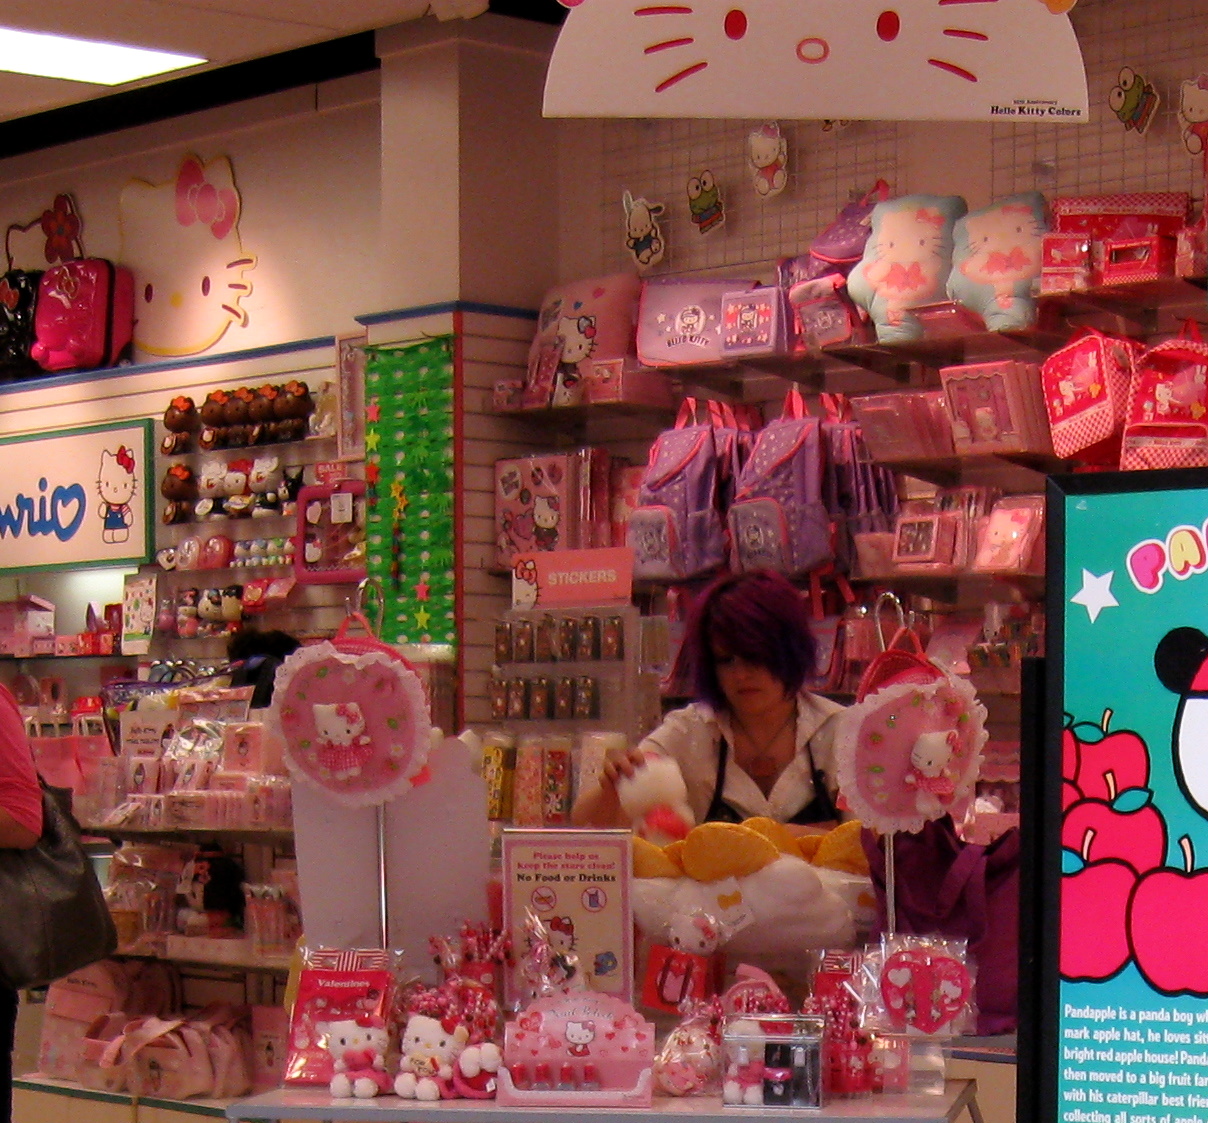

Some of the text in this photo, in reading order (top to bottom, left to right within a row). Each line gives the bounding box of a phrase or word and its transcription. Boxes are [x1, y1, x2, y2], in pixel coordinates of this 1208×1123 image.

[990, 106, 1082, 117] Hello Kitty Colors
[548, 569, 617, 585] STICKERS
[533, 851, 561, 860] Please
[565, 852, 585, 860] help
[517, 873, 532, 882] No
[535, 873, 560, 882] Food
[579, 873, 616, 882] Drinks
[318, 978, 370, 989] Valentines
[1064, 1004, 1116, 1022] Pandapple
[1118, 1007, 1128, 1020] is
[1129, 1011, 1136, 1020] a
[1138, 1008, 1170, 1023] panda
[1172, 1009, 1194, 1026] boy
[1063, 1026, 1090, 1039] mark
[1092, 1027, 1121, 1043] apple
[1123, 1028, 1144, 1043] hat,
[1147, 1029, 1161, 1042] he
[1163, 1029, 1191, 1043] loves
[1063, 1067, 1087, 1081] then
[1088, 1070, 1124, 1082] moved
[1125, 1072, 1137, 1083] to
[1139, 1075, 1146, 1084] a
[1148, 1071, 1166, 1088] big
[1167, 1072, 1191, 1086] fruit
